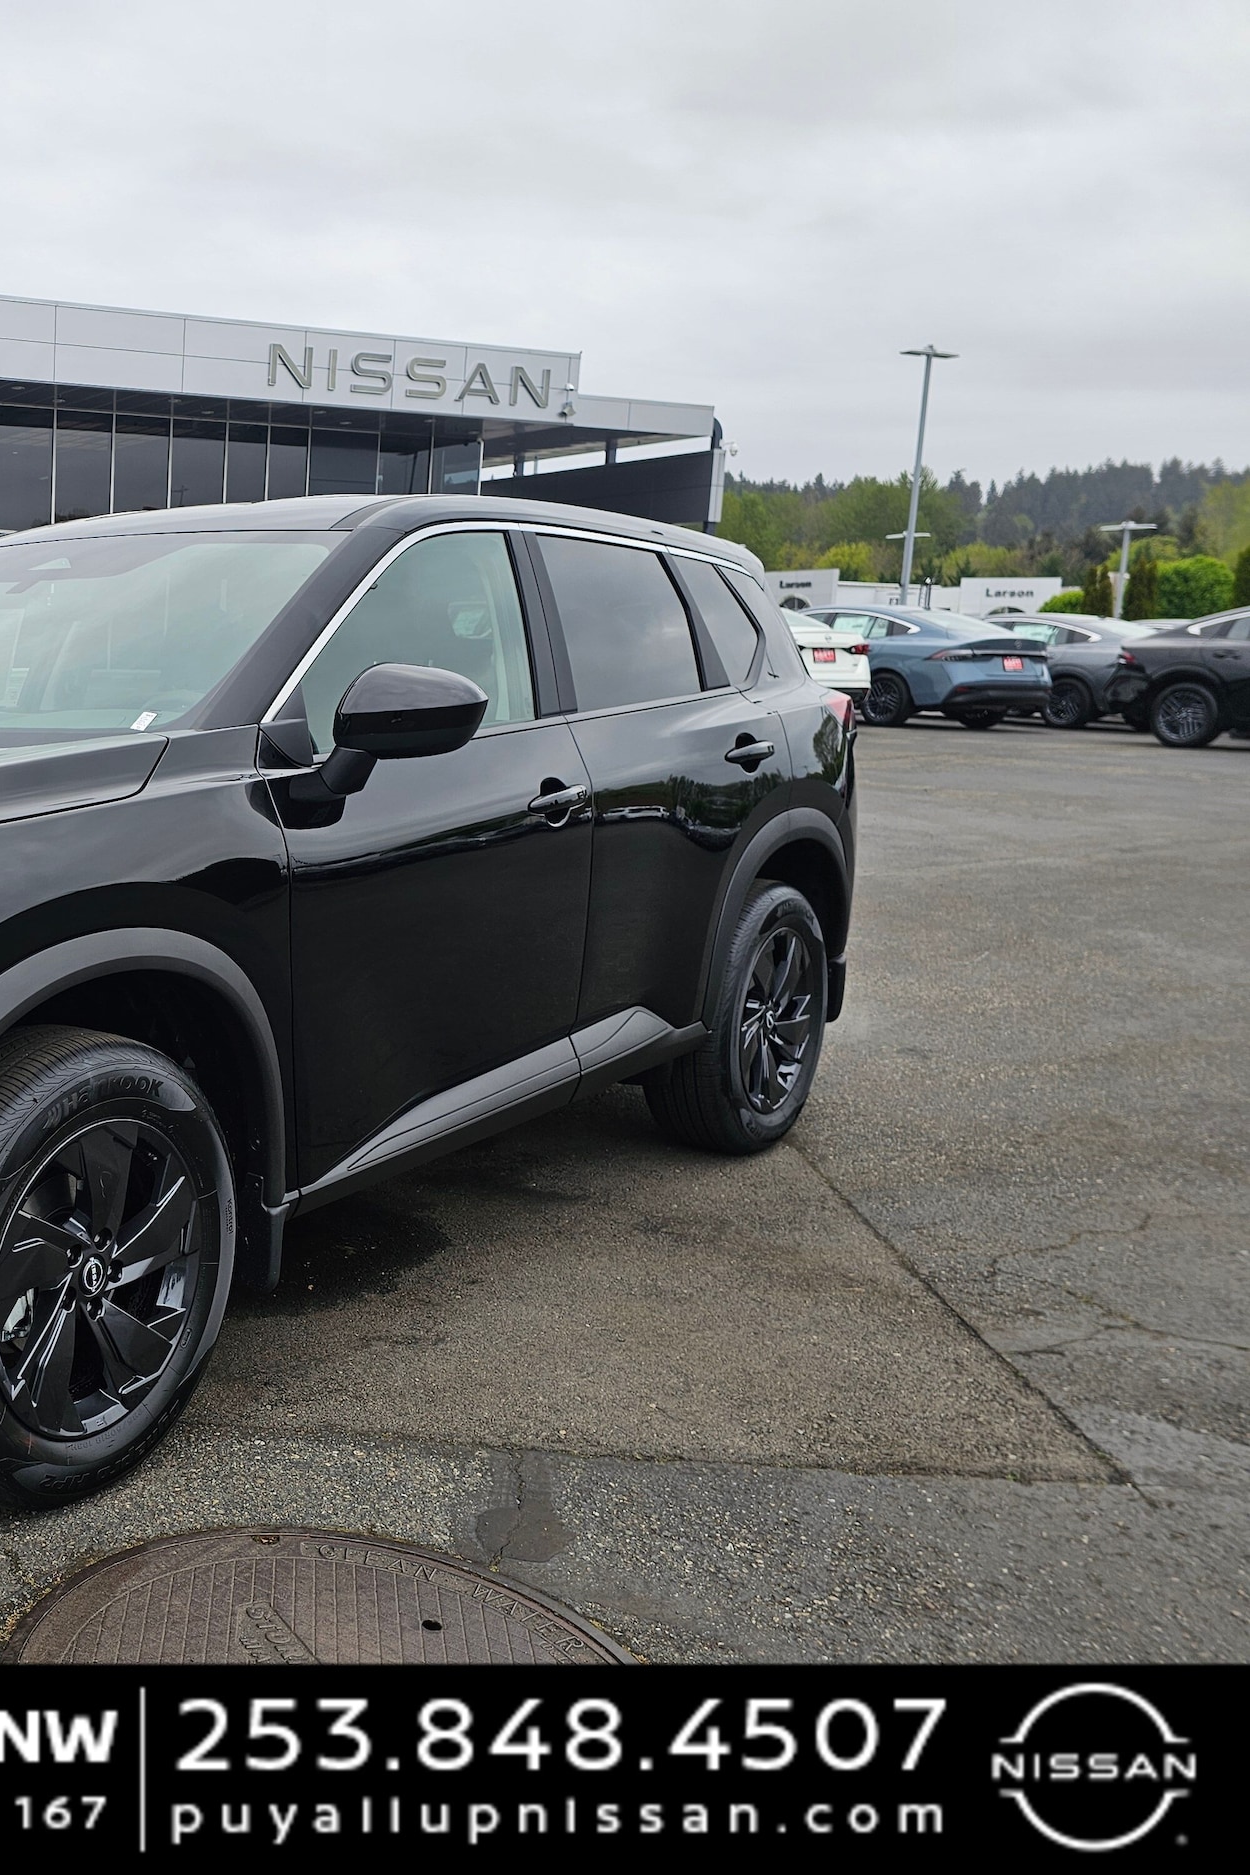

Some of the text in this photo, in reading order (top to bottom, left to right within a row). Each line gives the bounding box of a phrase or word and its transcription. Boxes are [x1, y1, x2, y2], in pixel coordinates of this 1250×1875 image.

[268, 343, 552, 408] NISSAN
[779, 579, 812, 589] Larson
[985, 587, 1035, 598] Larson
[318, 1543, 586, 1652] CLEAN WATER
